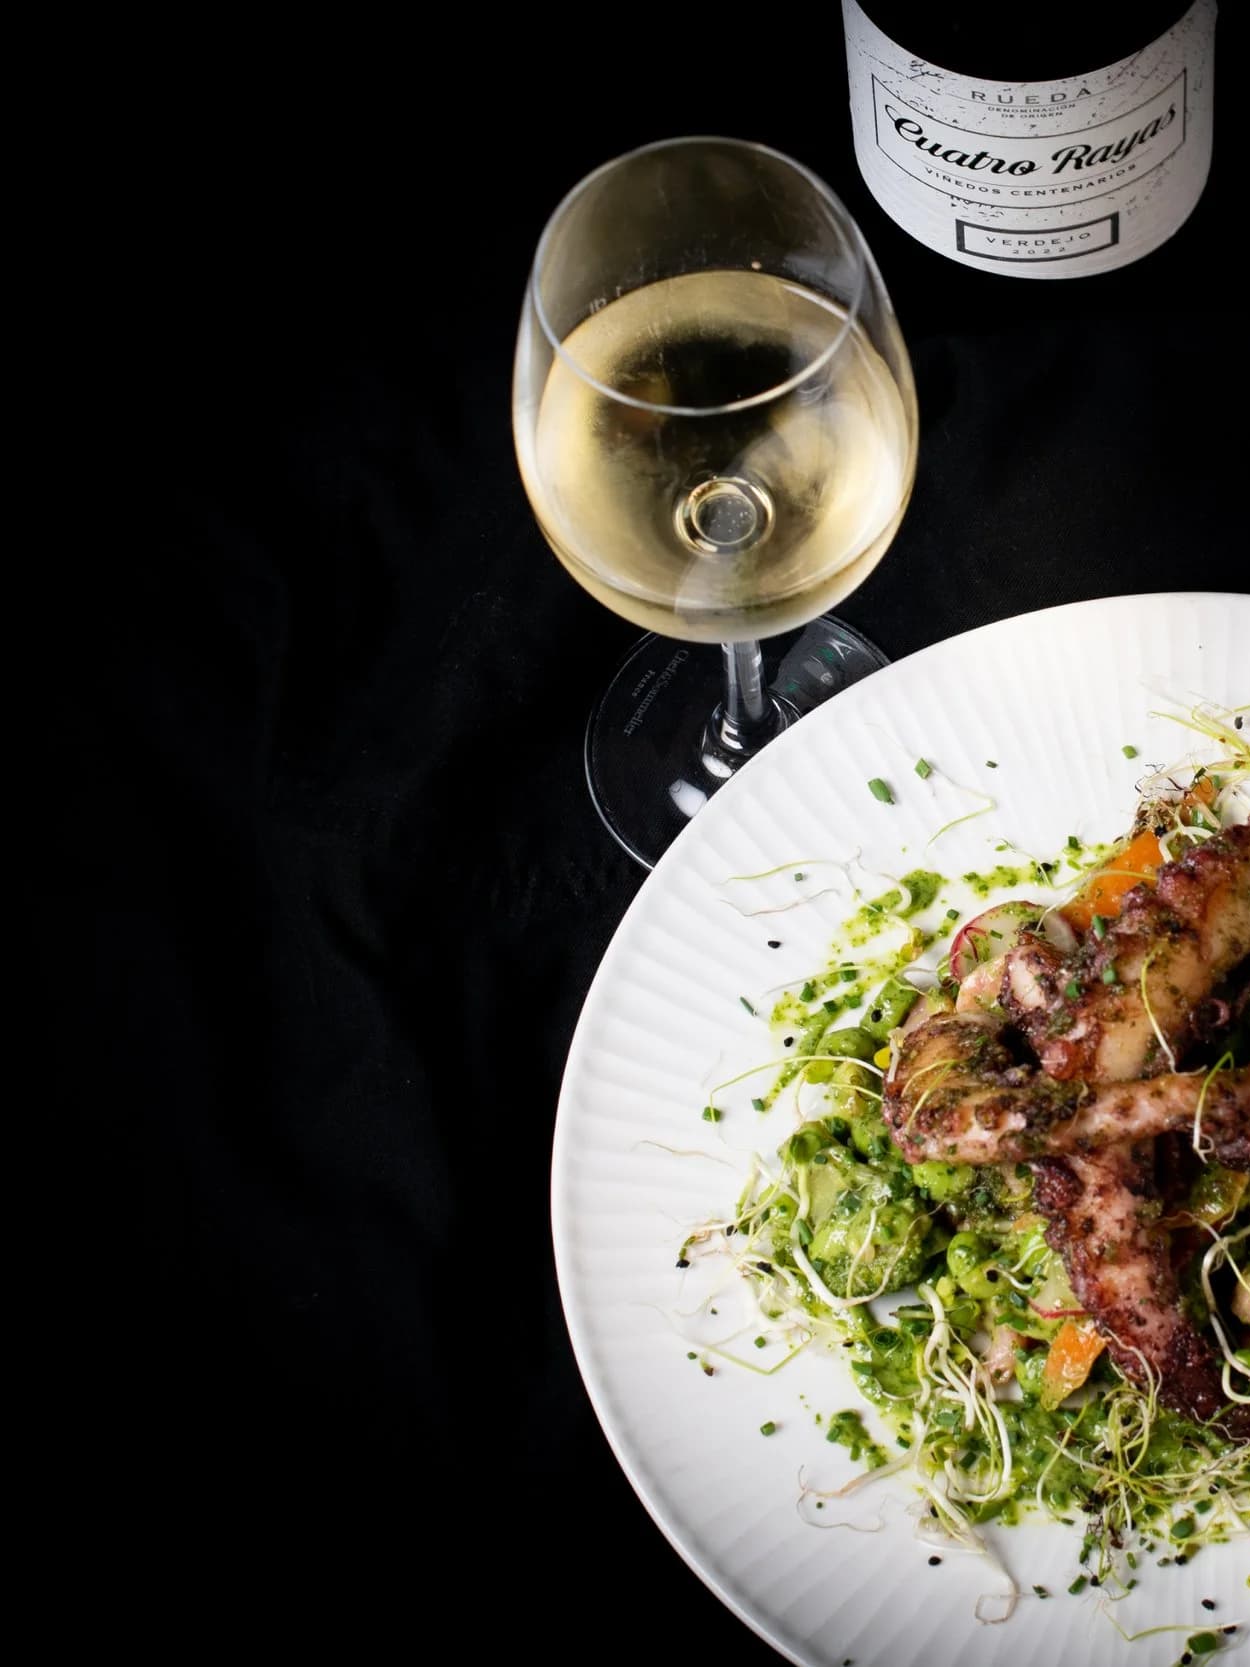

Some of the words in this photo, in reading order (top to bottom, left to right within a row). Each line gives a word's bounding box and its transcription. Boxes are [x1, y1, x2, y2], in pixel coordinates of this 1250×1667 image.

[971, 87, 1092, 105] RUEDA
[884, 104, 1043, 176] Cuatro
[1052, 103, 1176, 174] Rayas
[1010, 164, 1137, 197] CENTENARIOS
[986, 232, 1091, 247] VERDEJO
